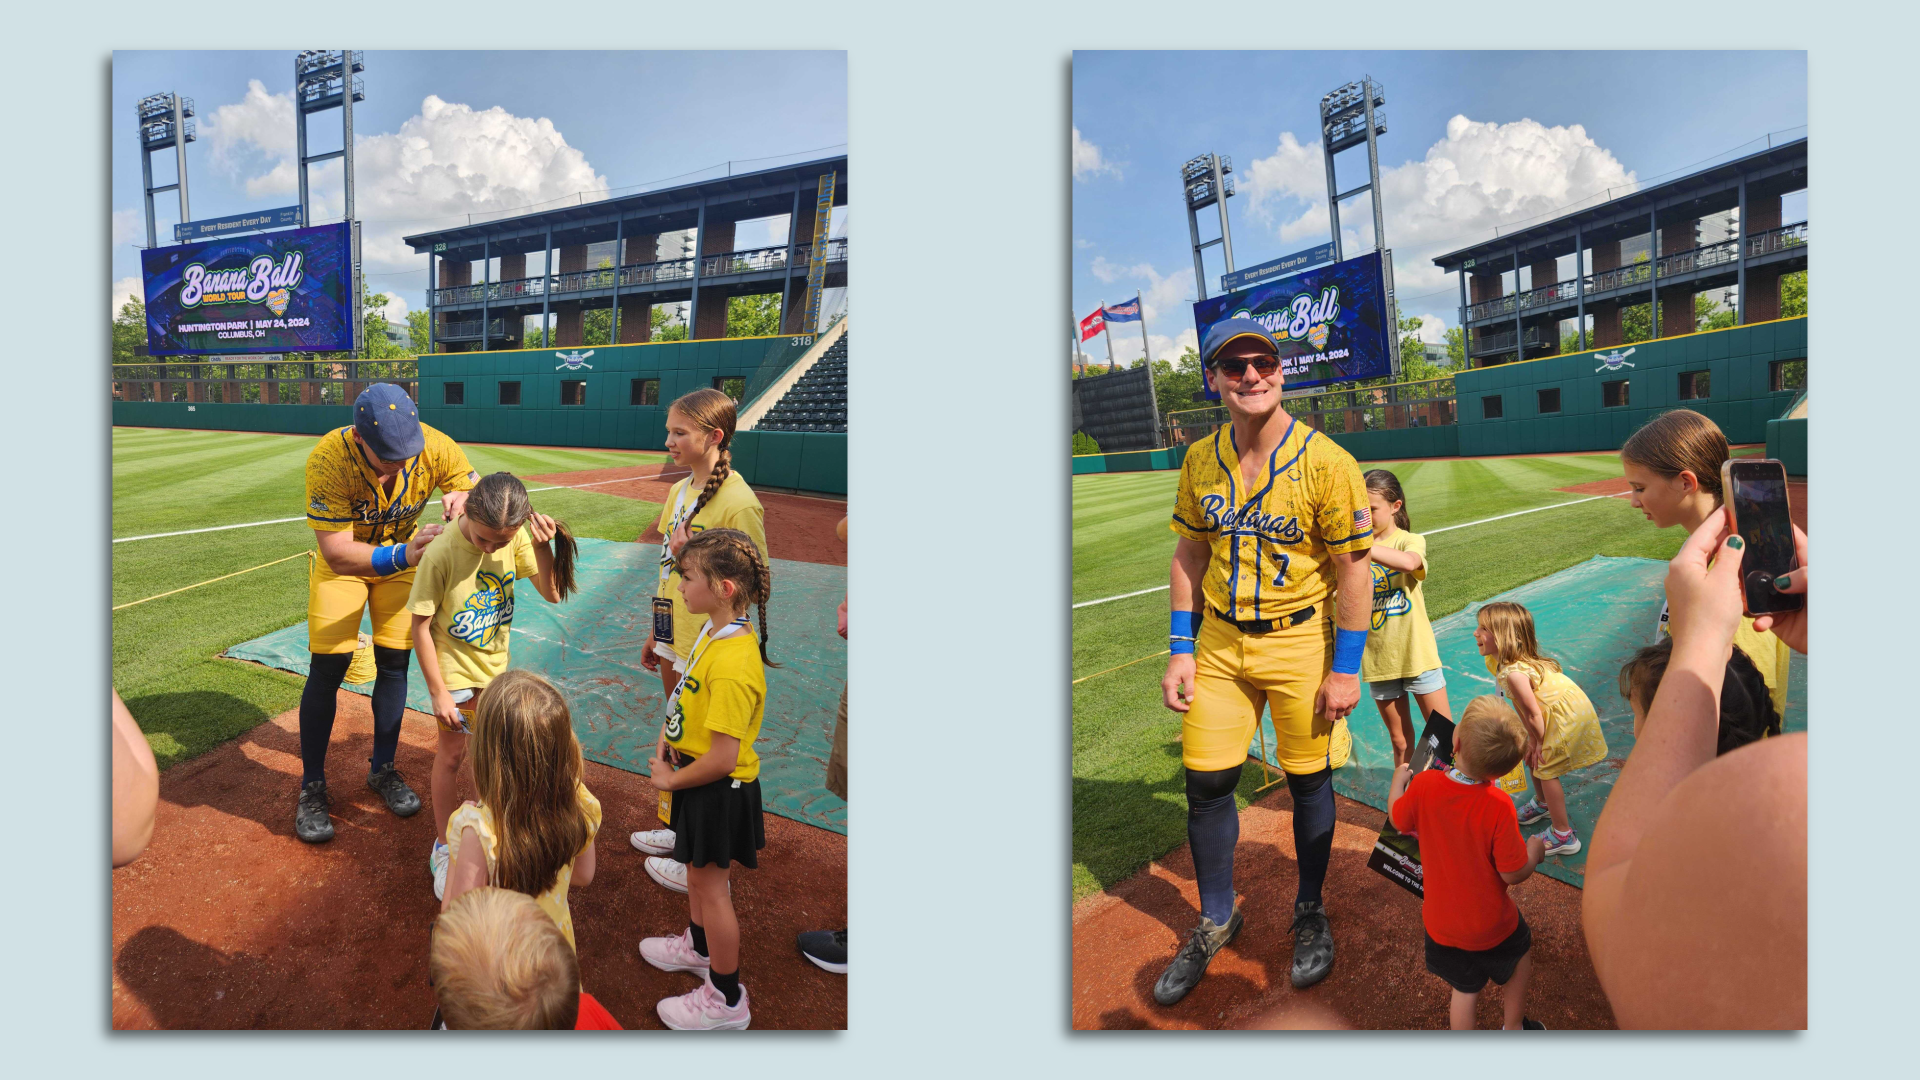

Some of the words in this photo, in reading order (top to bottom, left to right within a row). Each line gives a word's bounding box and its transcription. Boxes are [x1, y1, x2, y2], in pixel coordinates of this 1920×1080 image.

[816, 173, 835, 214] Ohio
[201, 223, 217, 232] EVERY
[217, 220, 242, 231] RESIDENT
[242, 217, 260, 227] EVERY
[260, 215, 271, 224] DAY
[818, 216, 831, 230] of
[434, 242, 447, 252] 328
[811, 232, 829, 262] Gas
[1244, 271, 1259, 280] EVERY
[1259, 264, 1281, 276] RESIDENT
[1281, 259, 1297, 270] EVERY
[1297, 256, 1308, 265] DAY
[1463, 258, 1476, 269] 328
[181, 264, 248, 305] Banana
[247, 253, 301, 301] Ball
[202, 293, 226, 303] WORLD
[226, 291, 246, 301] TOUR
[803, 266, 825, 333] Columbia
[1289, 288, 1338, 338] Ball
[178, 322, 227, 333] HUNTINGTON
[227, 320, 248, 330] PARK
[255, 319, 274, 329] MAY
[274, 318, 287, 330] 24,
[288, 317, 310, 327] 2024
[218, 329, 255, 339] COLUMBUS,
[255, 329, 265, 338] OH
[791, 335, 812, 347] 318
[1299, 353, 1315, 364] MAY
[1315, 352, 1329, 363] 24,
[1329, 348, 1350, 359] 2024
[1300, 364, 1309, 373] OH
[1200, 493, 1305, 546] Bananas
[1271, 552, 1290, 587] 7
[1382, 863, 1405, 880] WELCOME
[1404, 876, 1411, 884] TO
[1411, 880, 1420, 889] THE
